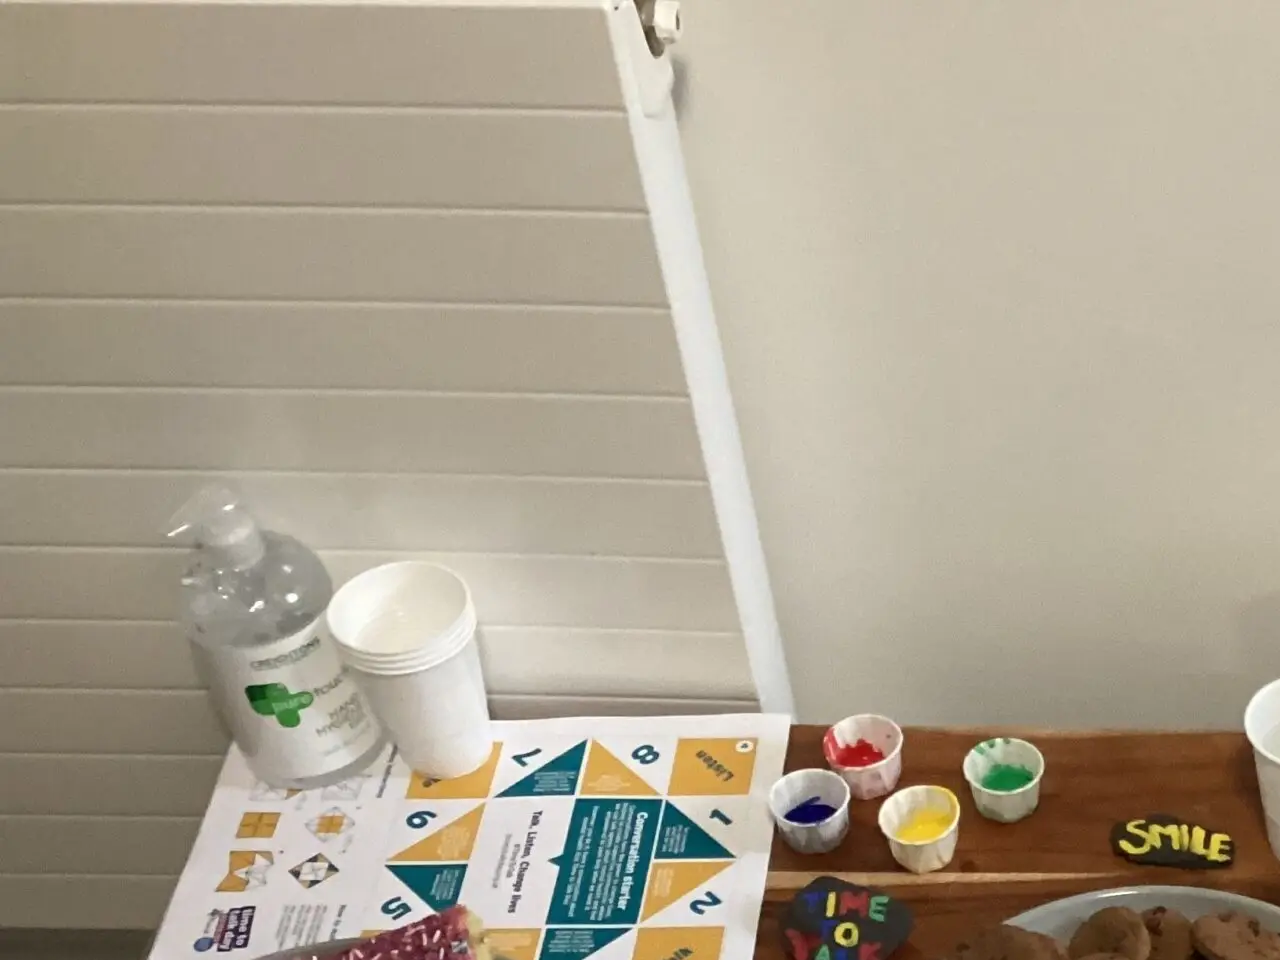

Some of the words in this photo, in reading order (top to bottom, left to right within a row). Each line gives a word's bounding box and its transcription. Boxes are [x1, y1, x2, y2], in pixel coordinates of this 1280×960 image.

[511, 748, 542, 767] 7
[631, 744, 660, 765] 8
[696, 750, 734, 782] Listen
[405, 810, 437, 829] 6
[709, 808, 733, 825] 1
[624, 811, 649, 875] Conversation
[1118, 819, 1231, 862] SMILE
[511, 861, 529, 892] Change
[617, 875, 634, 909] starter
[689, 891, 722, 915] 2
[381, 896, 412, 920] 5
[803, 891, 889, 922] TIME
